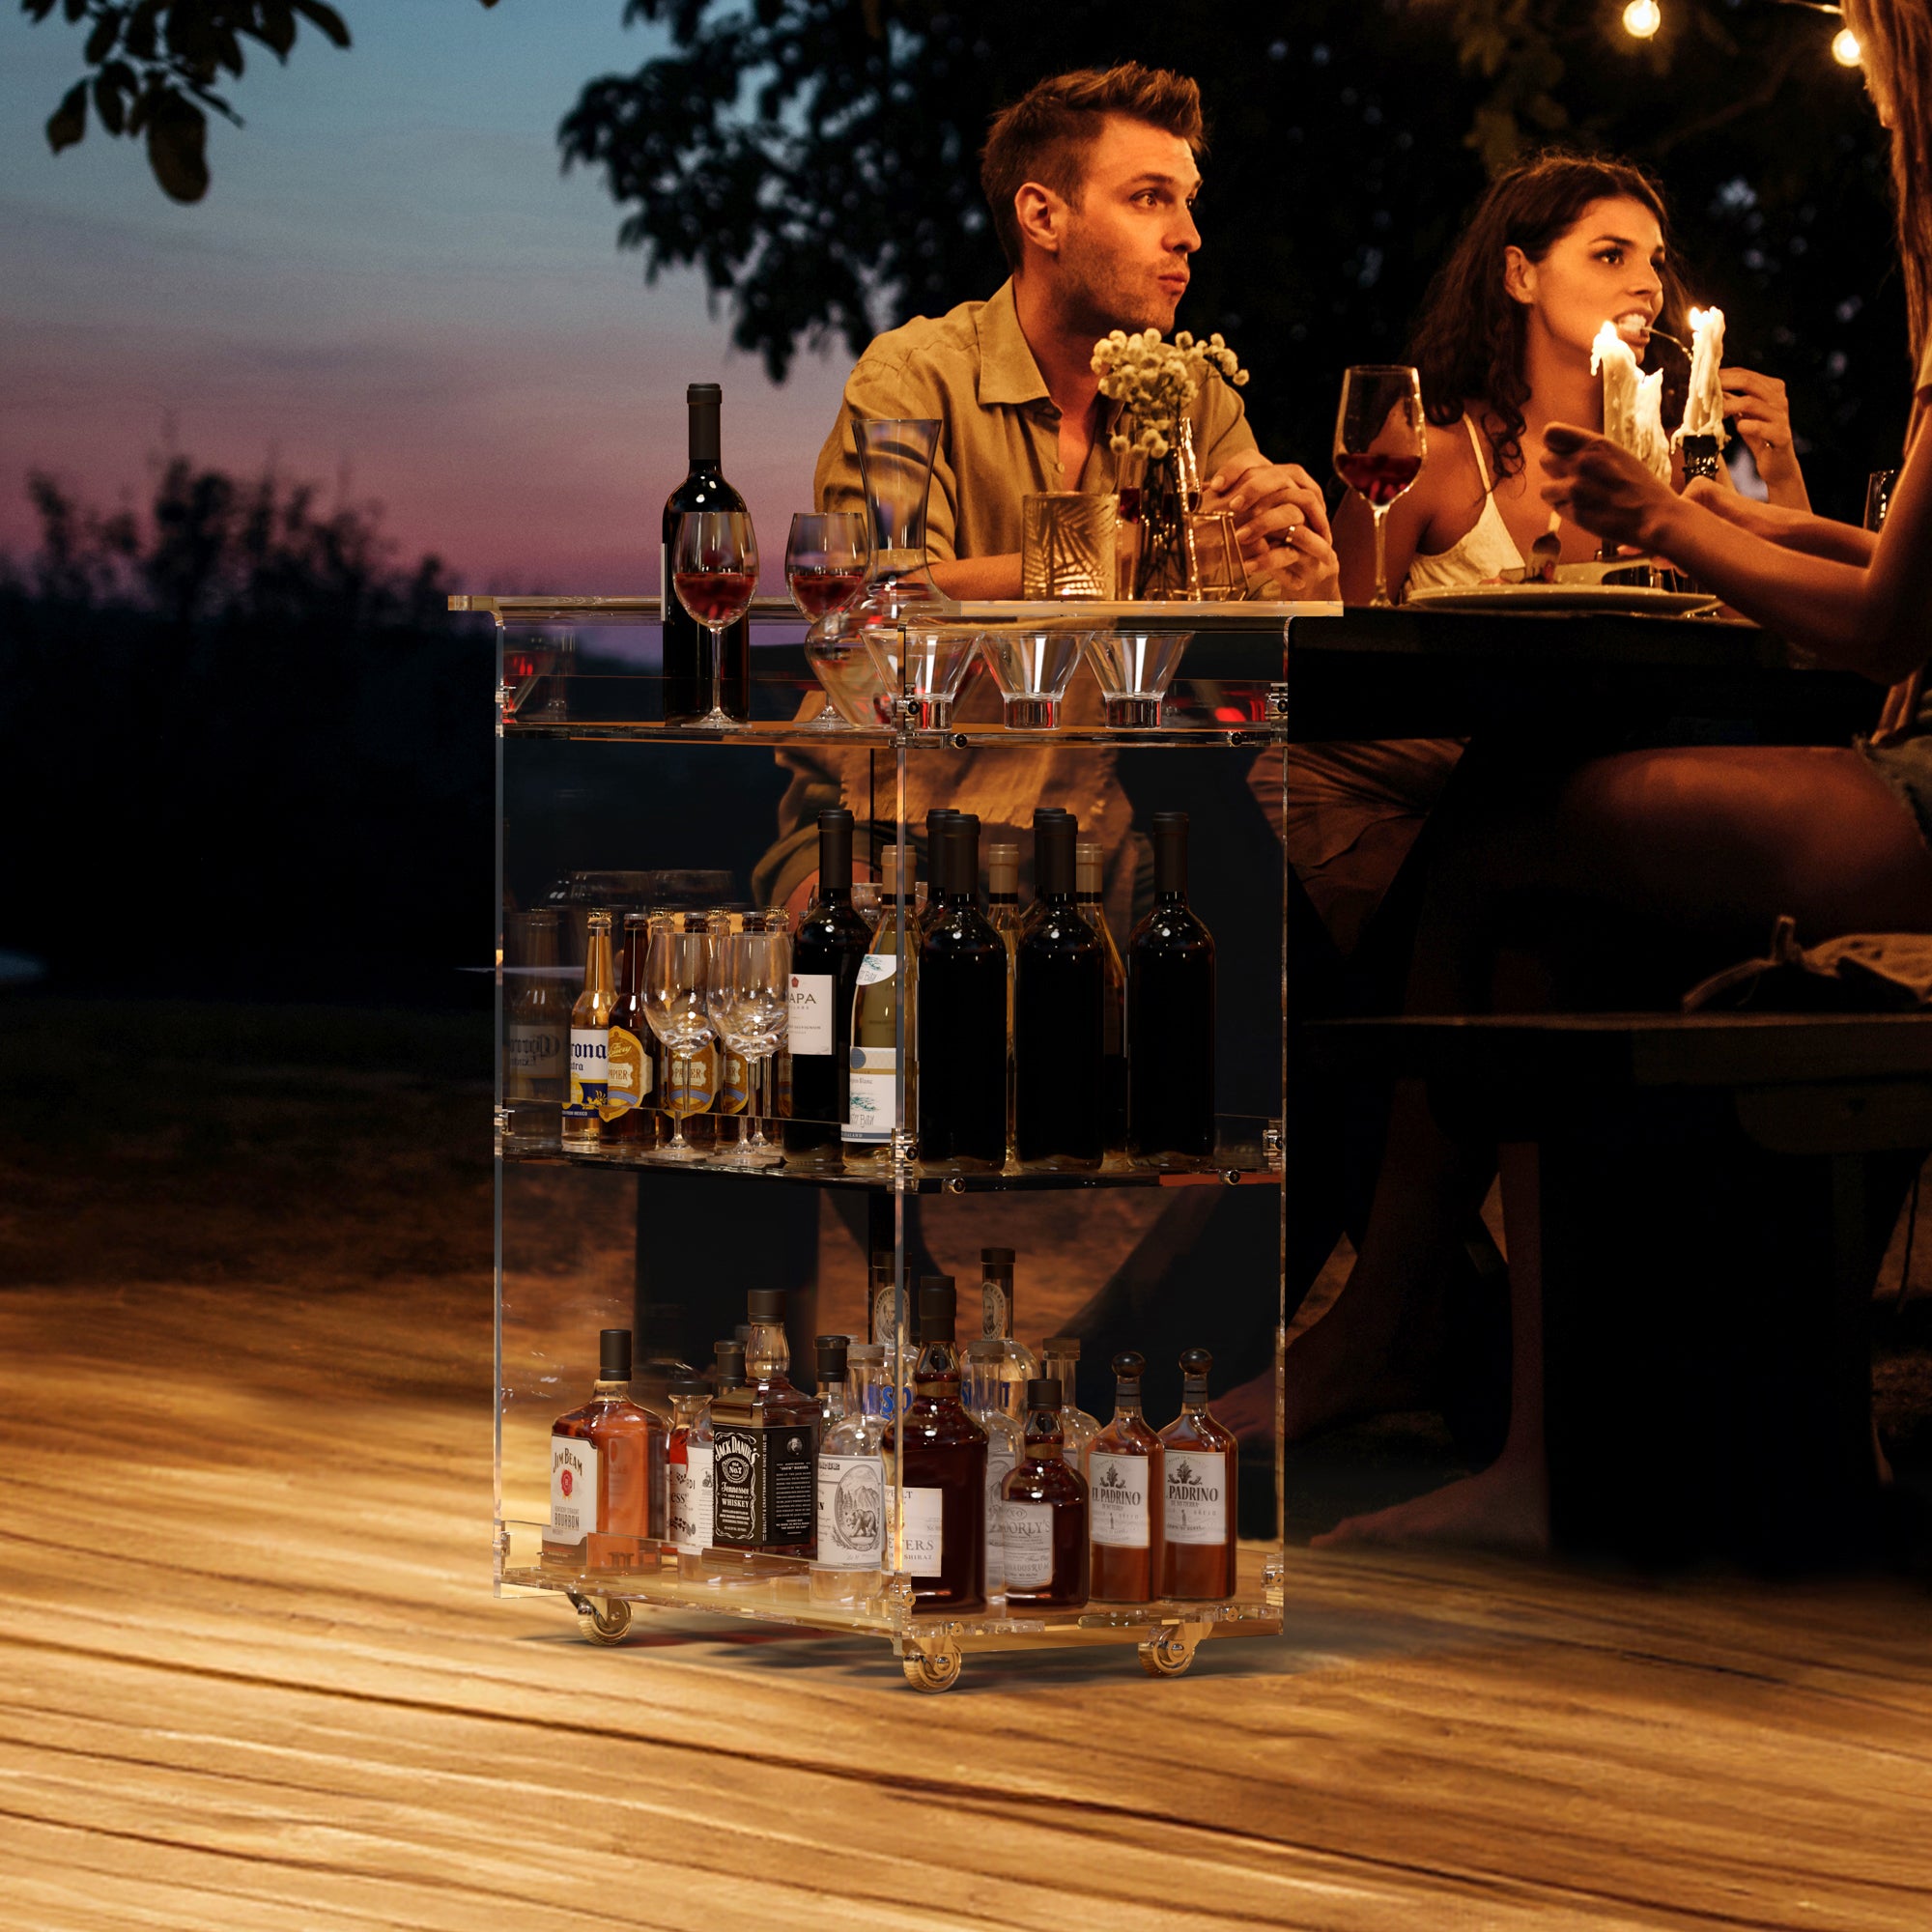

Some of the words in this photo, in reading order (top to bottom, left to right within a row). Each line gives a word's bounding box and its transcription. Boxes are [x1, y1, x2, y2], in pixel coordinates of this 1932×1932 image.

[715, 1440, 731, 1462] JACK
[731, 1435, 760, 1465] DANIEL'S
[553, 1451, 564, 1474] JIM
[564, 1448, 582, 1477] BEAM
[721, 1482, 750, 1495] Tennessee
[1169, 1485, 1219, 1502] PADRINO
[722, 1498, 750, 1508] WHISKEY
[1101, 1489, 1141, 1506] PADRINO
[554, 1512, 580, 1529] BOURBON
